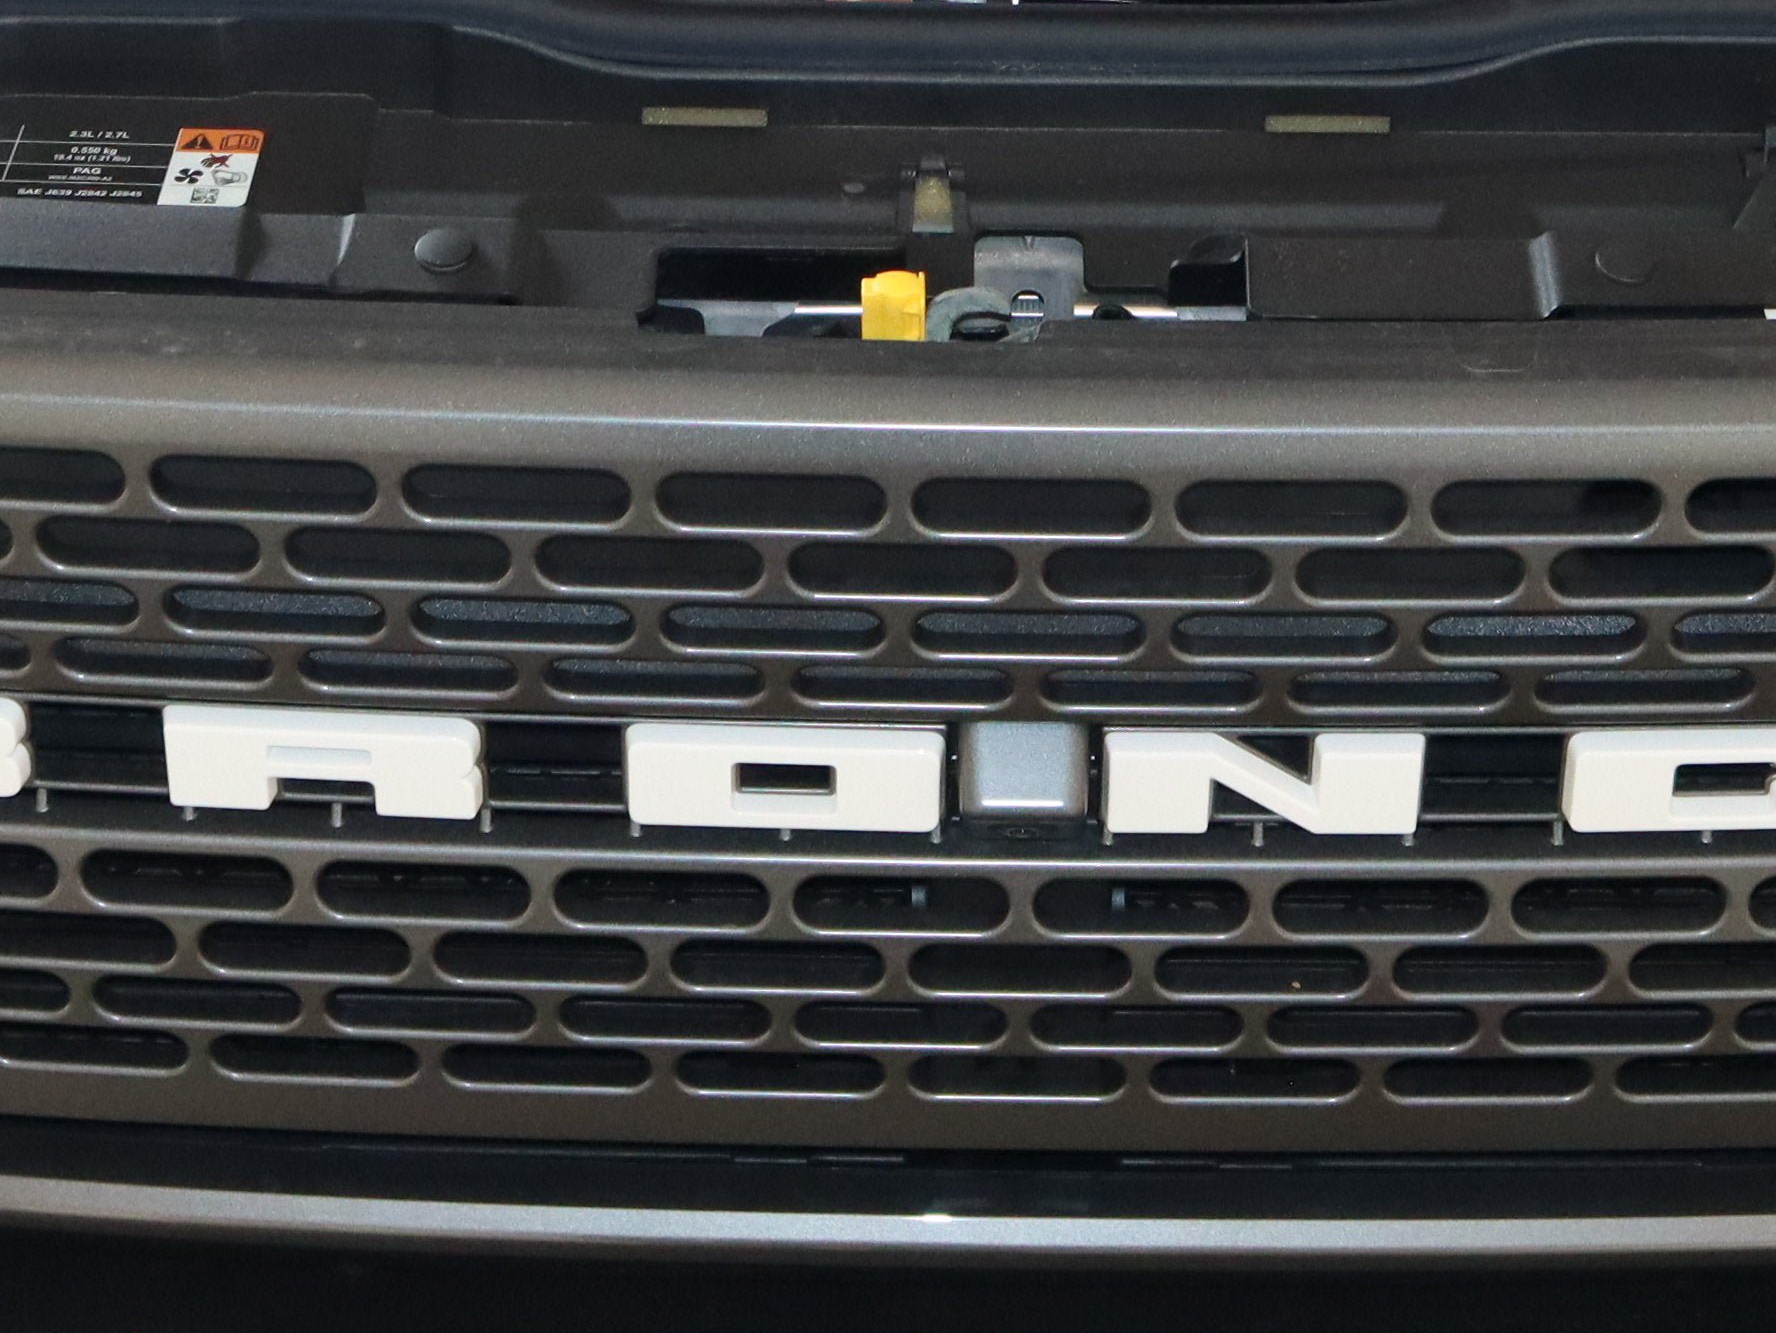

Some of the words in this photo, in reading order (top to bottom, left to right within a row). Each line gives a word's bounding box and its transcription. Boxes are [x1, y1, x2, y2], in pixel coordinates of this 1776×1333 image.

[104, 131, 130, 139] 2.7L
[103, 148, 118, 156] kg
[72, 167, 102, 175] PAG
